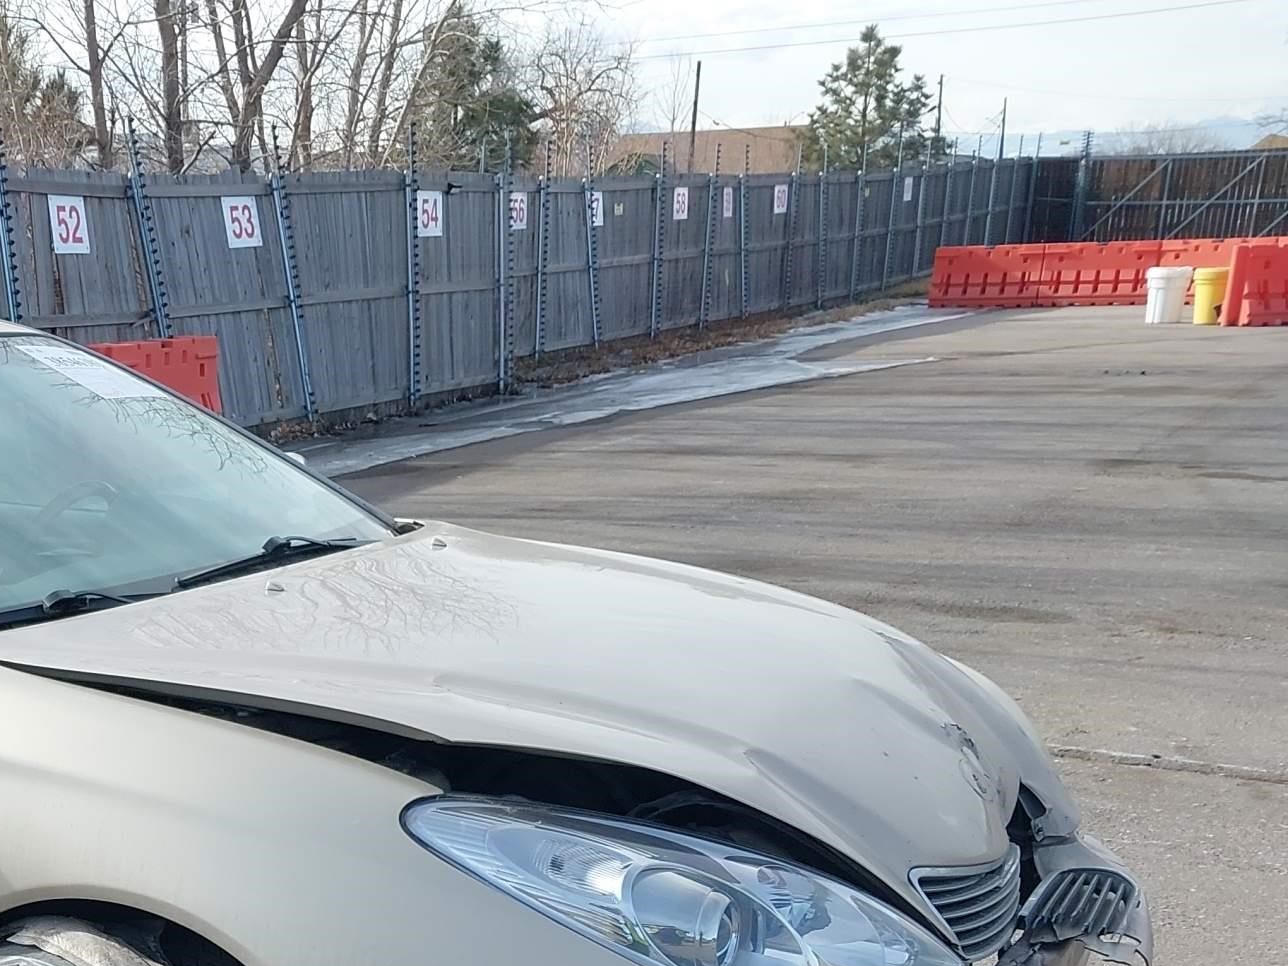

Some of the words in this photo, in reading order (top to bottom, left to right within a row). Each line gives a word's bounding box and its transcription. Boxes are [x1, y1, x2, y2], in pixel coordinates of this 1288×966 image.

[56, 204, 84, 244] 52
[229, 204, 255, 239] 53
[421, 198, 439, 229] 54
[511, 198, 525, 224] 56
